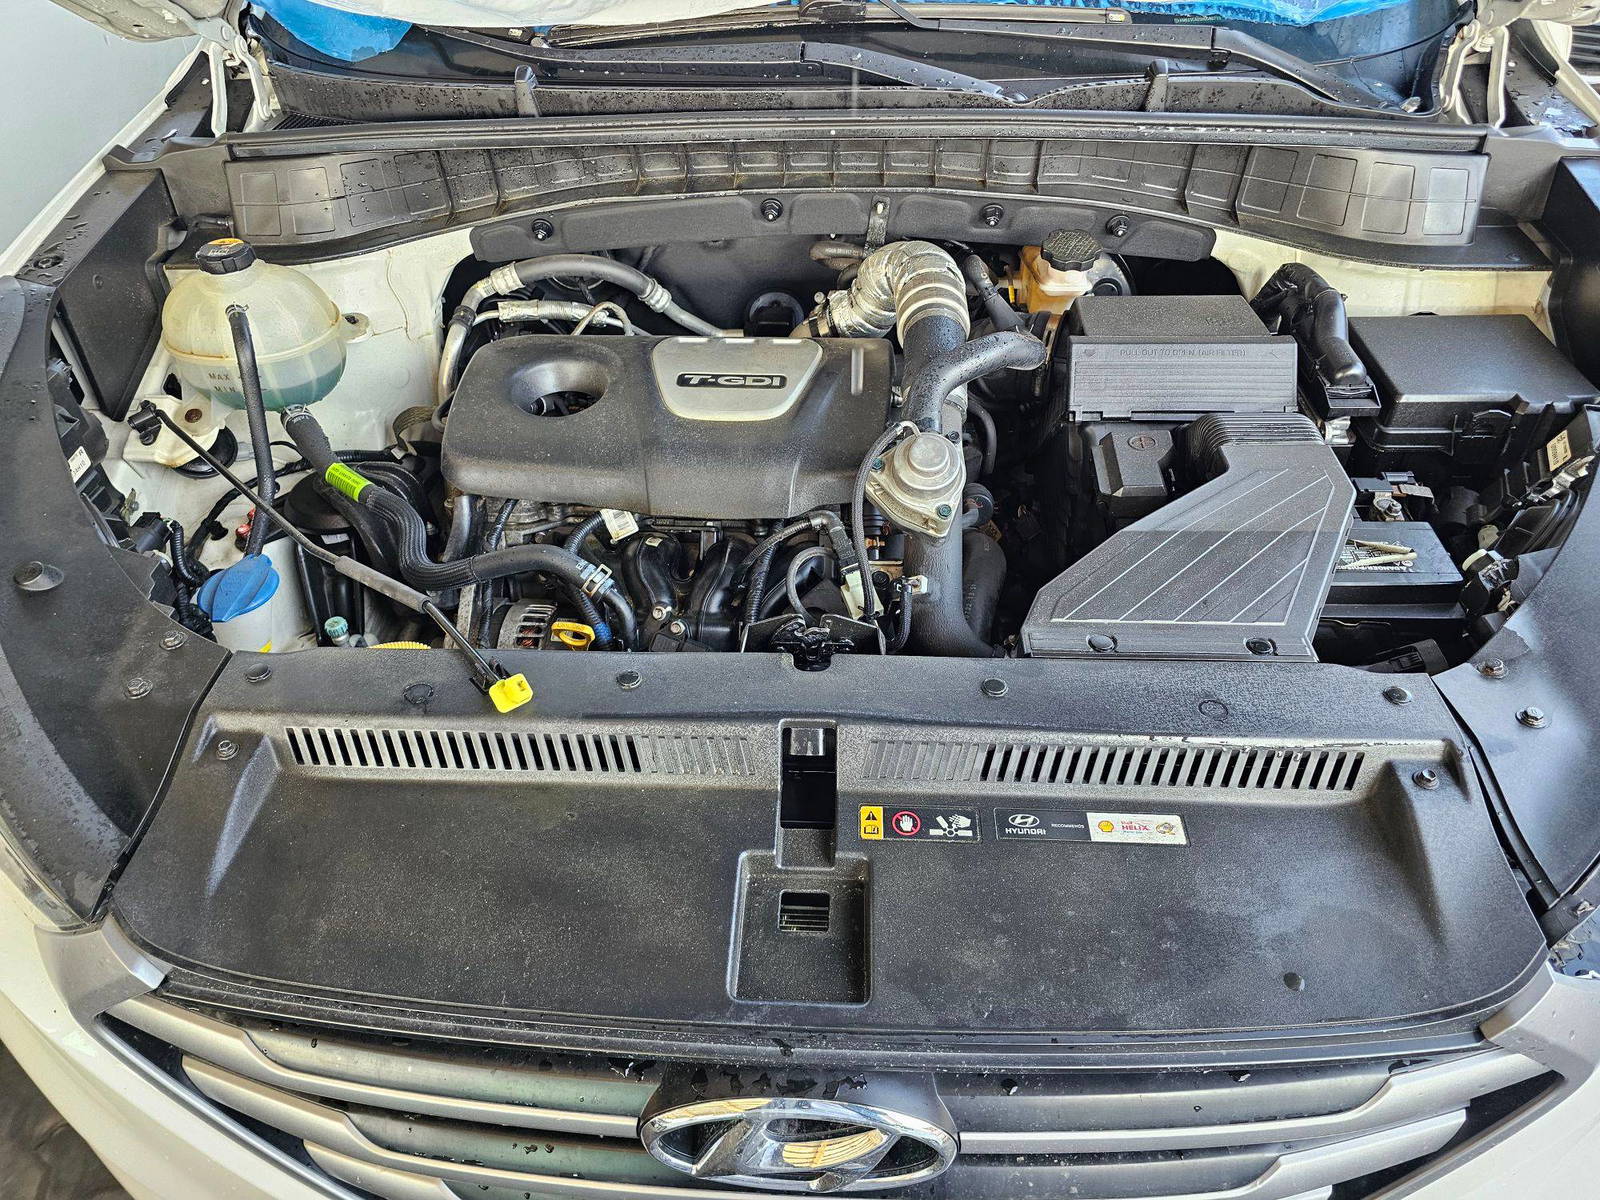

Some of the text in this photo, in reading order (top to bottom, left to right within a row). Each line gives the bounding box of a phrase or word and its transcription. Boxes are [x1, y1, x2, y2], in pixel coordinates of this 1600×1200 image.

[684, 374, 781, 387] T-GDI
[214, 385, 236, 393] MIN
[1005, 827, 1047, 836] HYUNDAI
